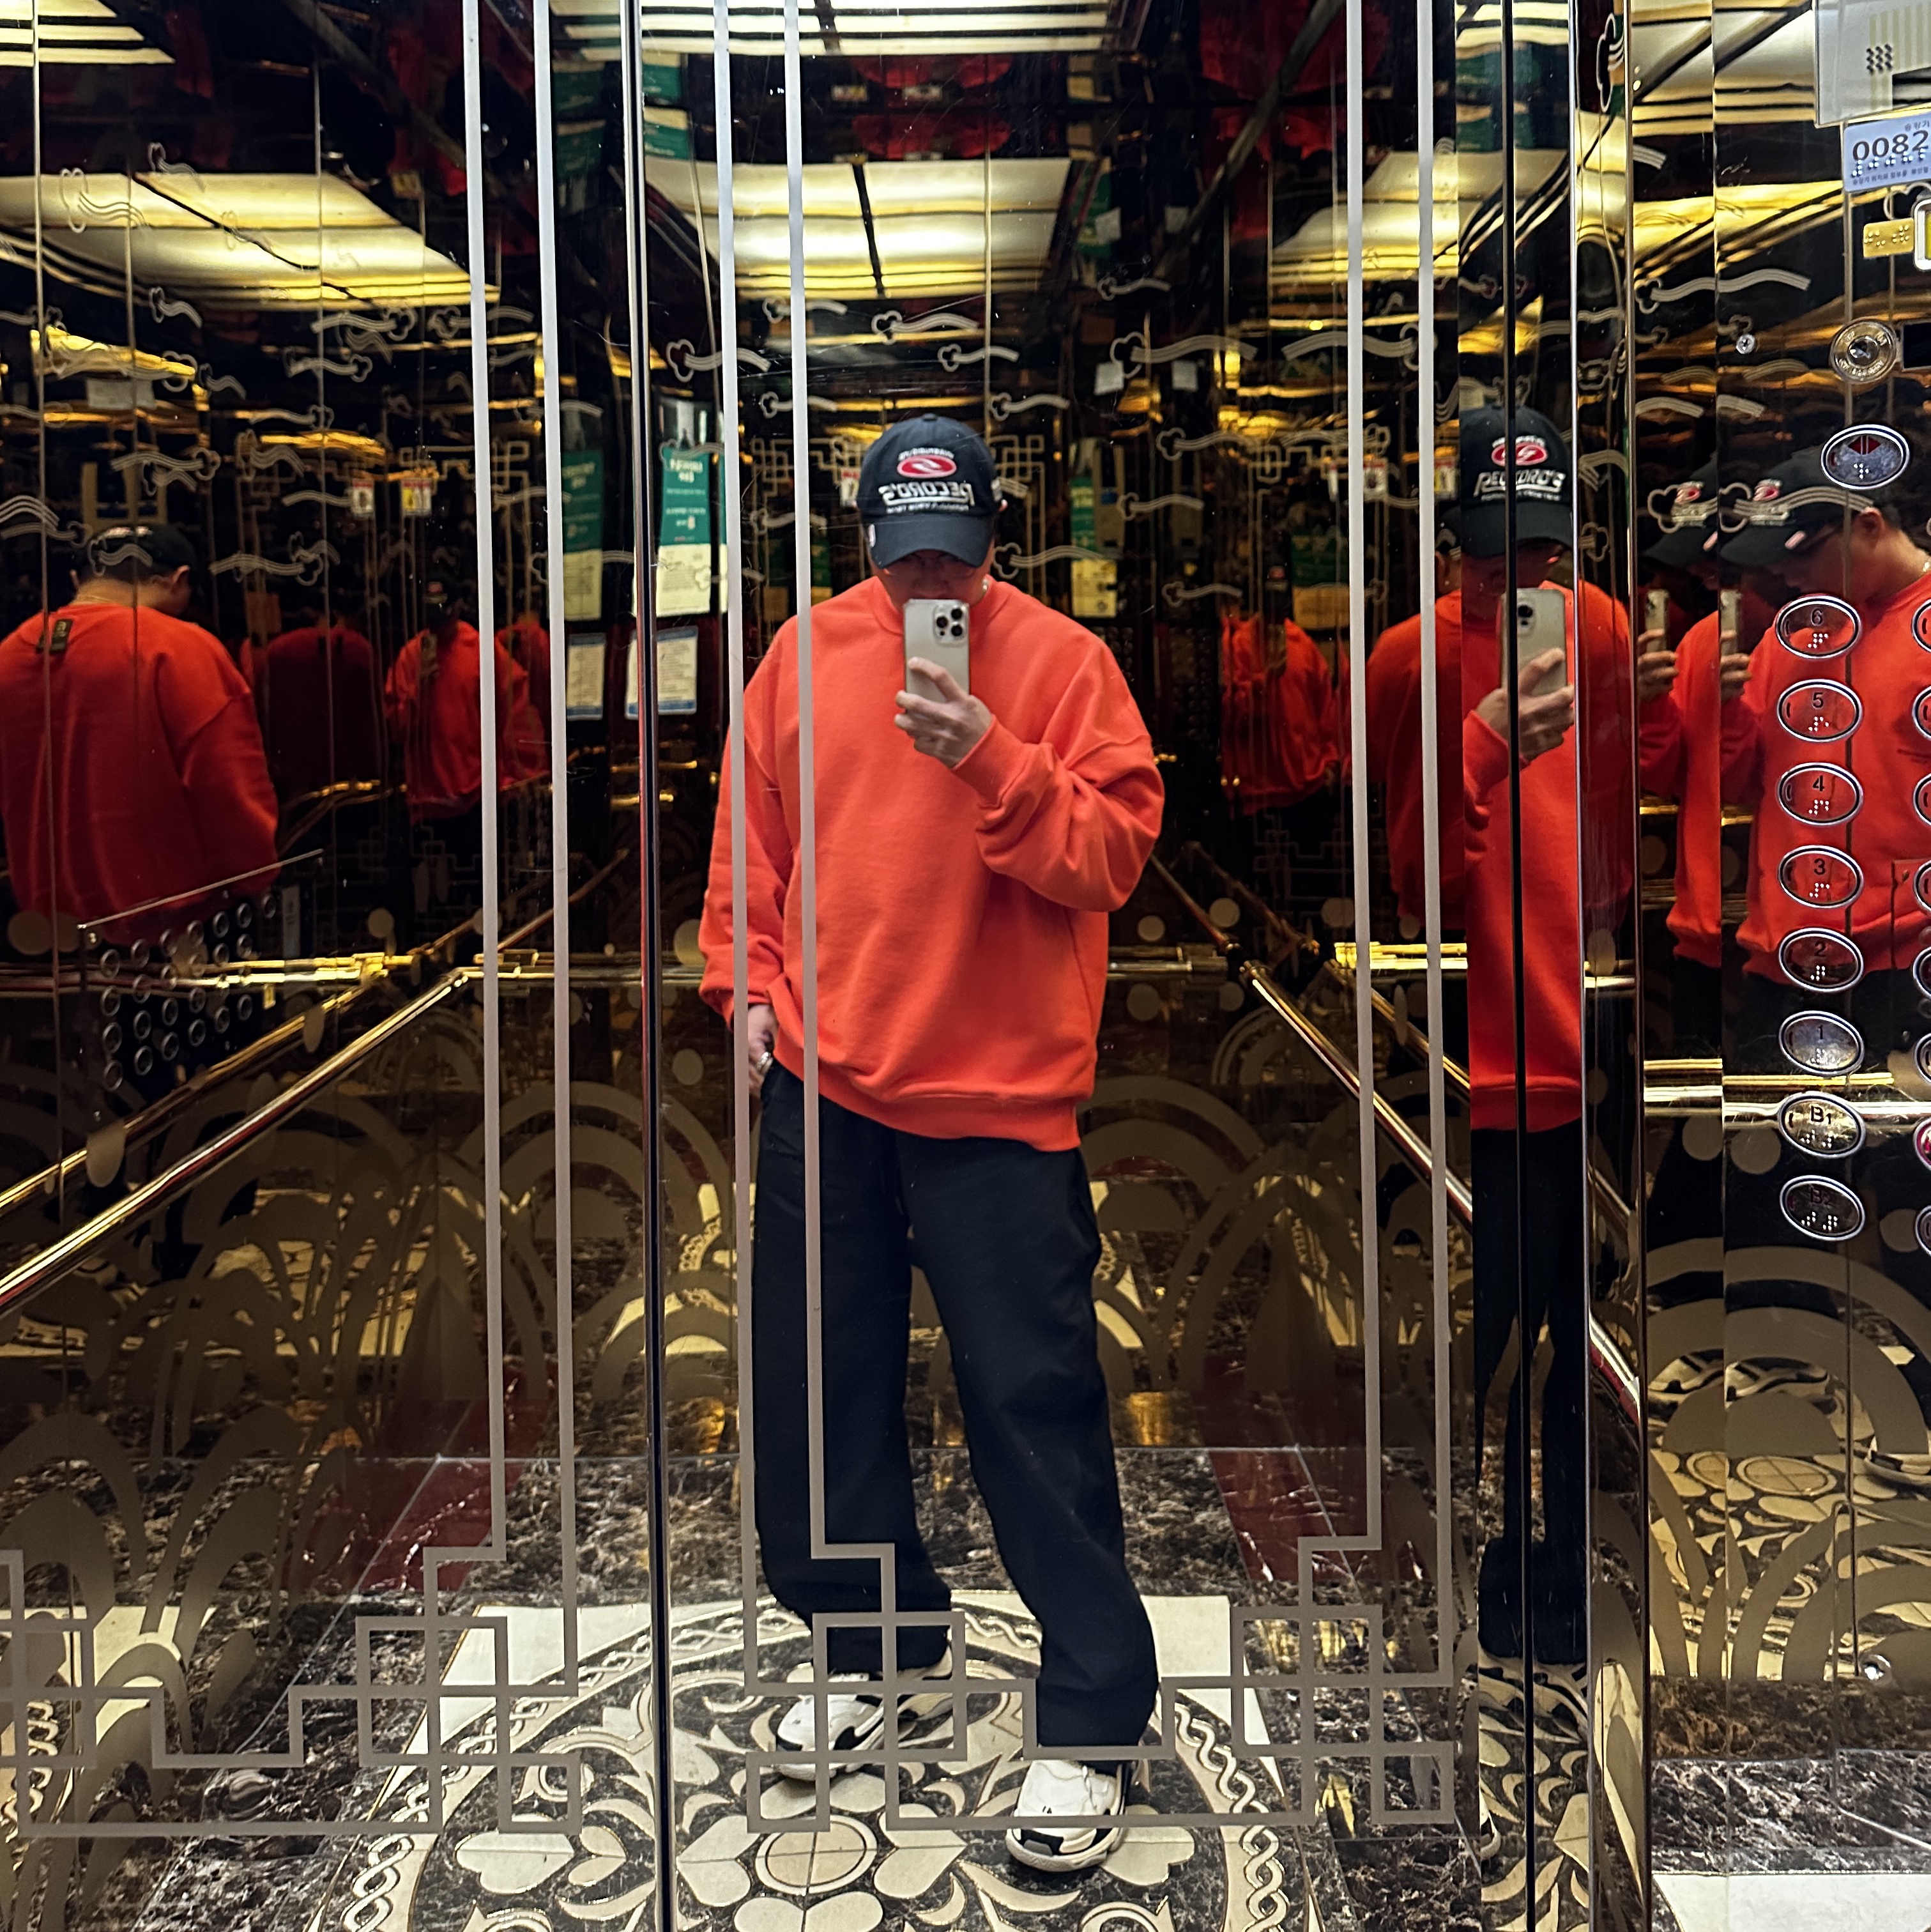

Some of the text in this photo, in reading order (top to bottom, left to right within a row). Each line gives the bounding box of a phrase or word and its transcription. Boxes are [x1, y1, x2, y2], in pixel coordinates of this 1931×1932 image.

[1852, 130, 1928, 161] 0082
[1811, 608, 1823, 626] 6
[1812, 692, 1824, 709] 5
[1812, 775, 1825, 792] 4
[1813, 858, 1826, 875] 3
[1815, 941, 1826, 957] 2
[1810, 1105, 1831, 1124] B1
